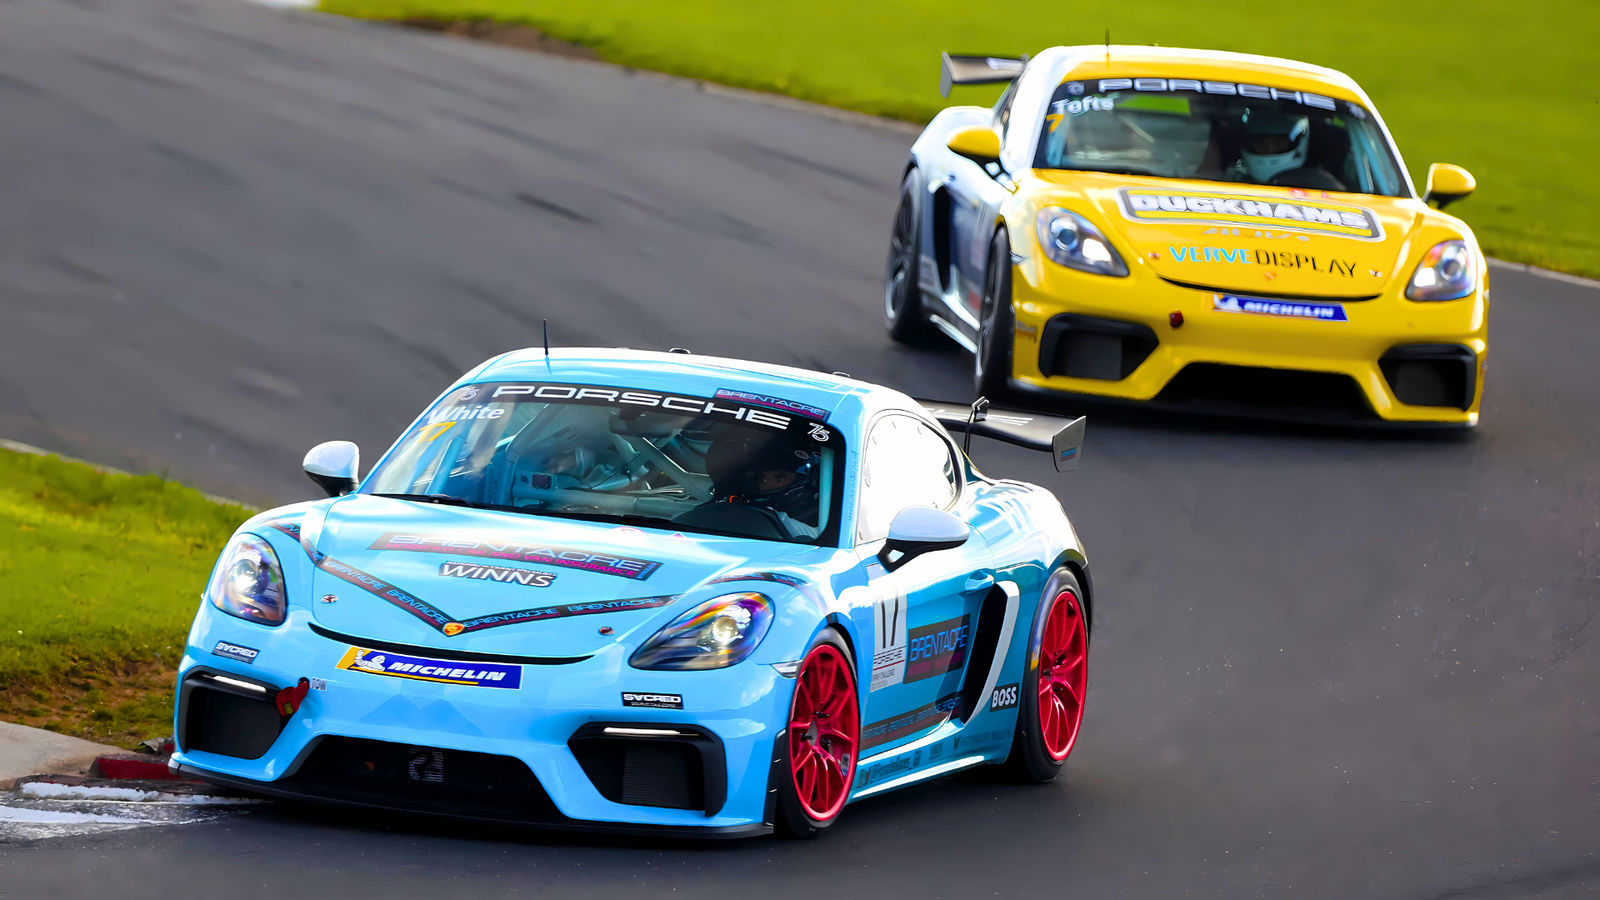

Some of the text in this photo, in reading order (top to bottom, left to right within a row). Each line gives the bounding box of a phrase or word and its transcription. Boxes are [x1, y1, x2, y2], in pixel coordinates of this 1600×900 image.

[1098, 78, 1337, 112] PORSCHE
[1046, 114, 1064, 133] 7
[1130, 194, 1370, 229] DUCKHAMS
[1169, 246, 1357, 278] VERVE DISPLAY
[1244, 301, 1335, 318] MICHELIN
[492, 385, 791, 430] PORSCHE
[717, 389, 826, 417] BRENTACRE
[427, 405, 505, 425] White
[417, 421, 457, 444] 17
[389, 535, 647, 572] BRENTACRE
[443, 564, 555, 587] WINNS
[554, 558, 637, 577] INSURANCE
[387, 589, 450, 624] BRENTACRE
[567, 598, 662, 612] BRENTACRE
[464, 608, 559, 628] BRENTACRE
[909, 624, 968, 662] BRENTACRE
[387, 661, 507, 682] MICHELIN
[991, 686, 1017, 708] BOSS
